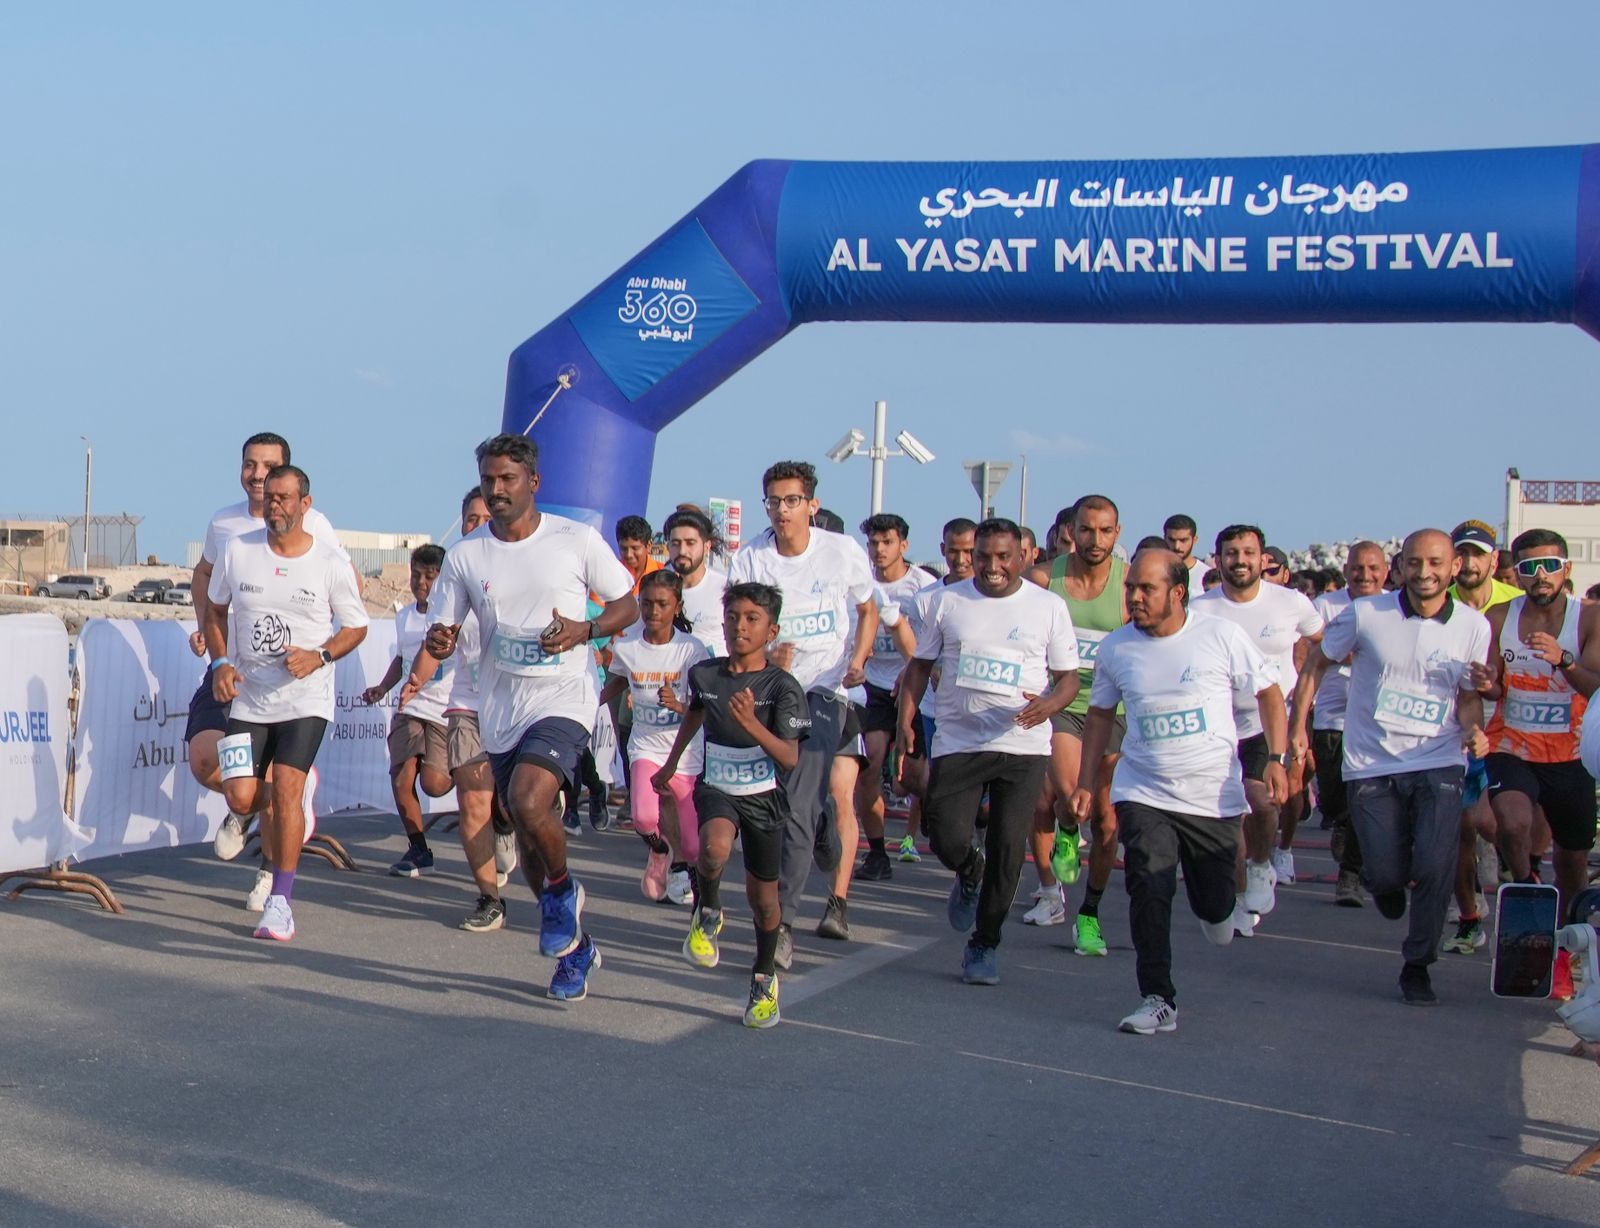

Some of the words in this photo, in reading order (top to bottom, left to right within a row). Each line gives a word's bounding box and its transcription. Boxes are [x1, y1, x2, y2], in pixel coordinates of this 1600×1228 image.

[918, 178, 1060, 229] البحري
[1069, 175, 1234, 217] الياسات
[1244, 174, 1409, 216] مهرجان
[826, 238, 882, 272] AL
[895, 237, 1038, 273] YASAT
[1054, 236, 1248, 273] MARINE
[1266, 231, 1515, 272] FESTIVAL
[626, 276, 649, 289] Abu
[618, 289, 697, 326] 360
[780, 613, 831, 638] 3090
[962, 657, 1016, 684] 3034
[1383, 692, 1441, 722] 3083
[1507, 701, 1566, 723] 3072
[333, 723, 356, 740] ABU
[358, 722, 387, 740] DHABI
[1142, 711, 1201, 738] 3035
[132, 740, 176, 769] Abu
[709, 760, 769, 784] 3058
